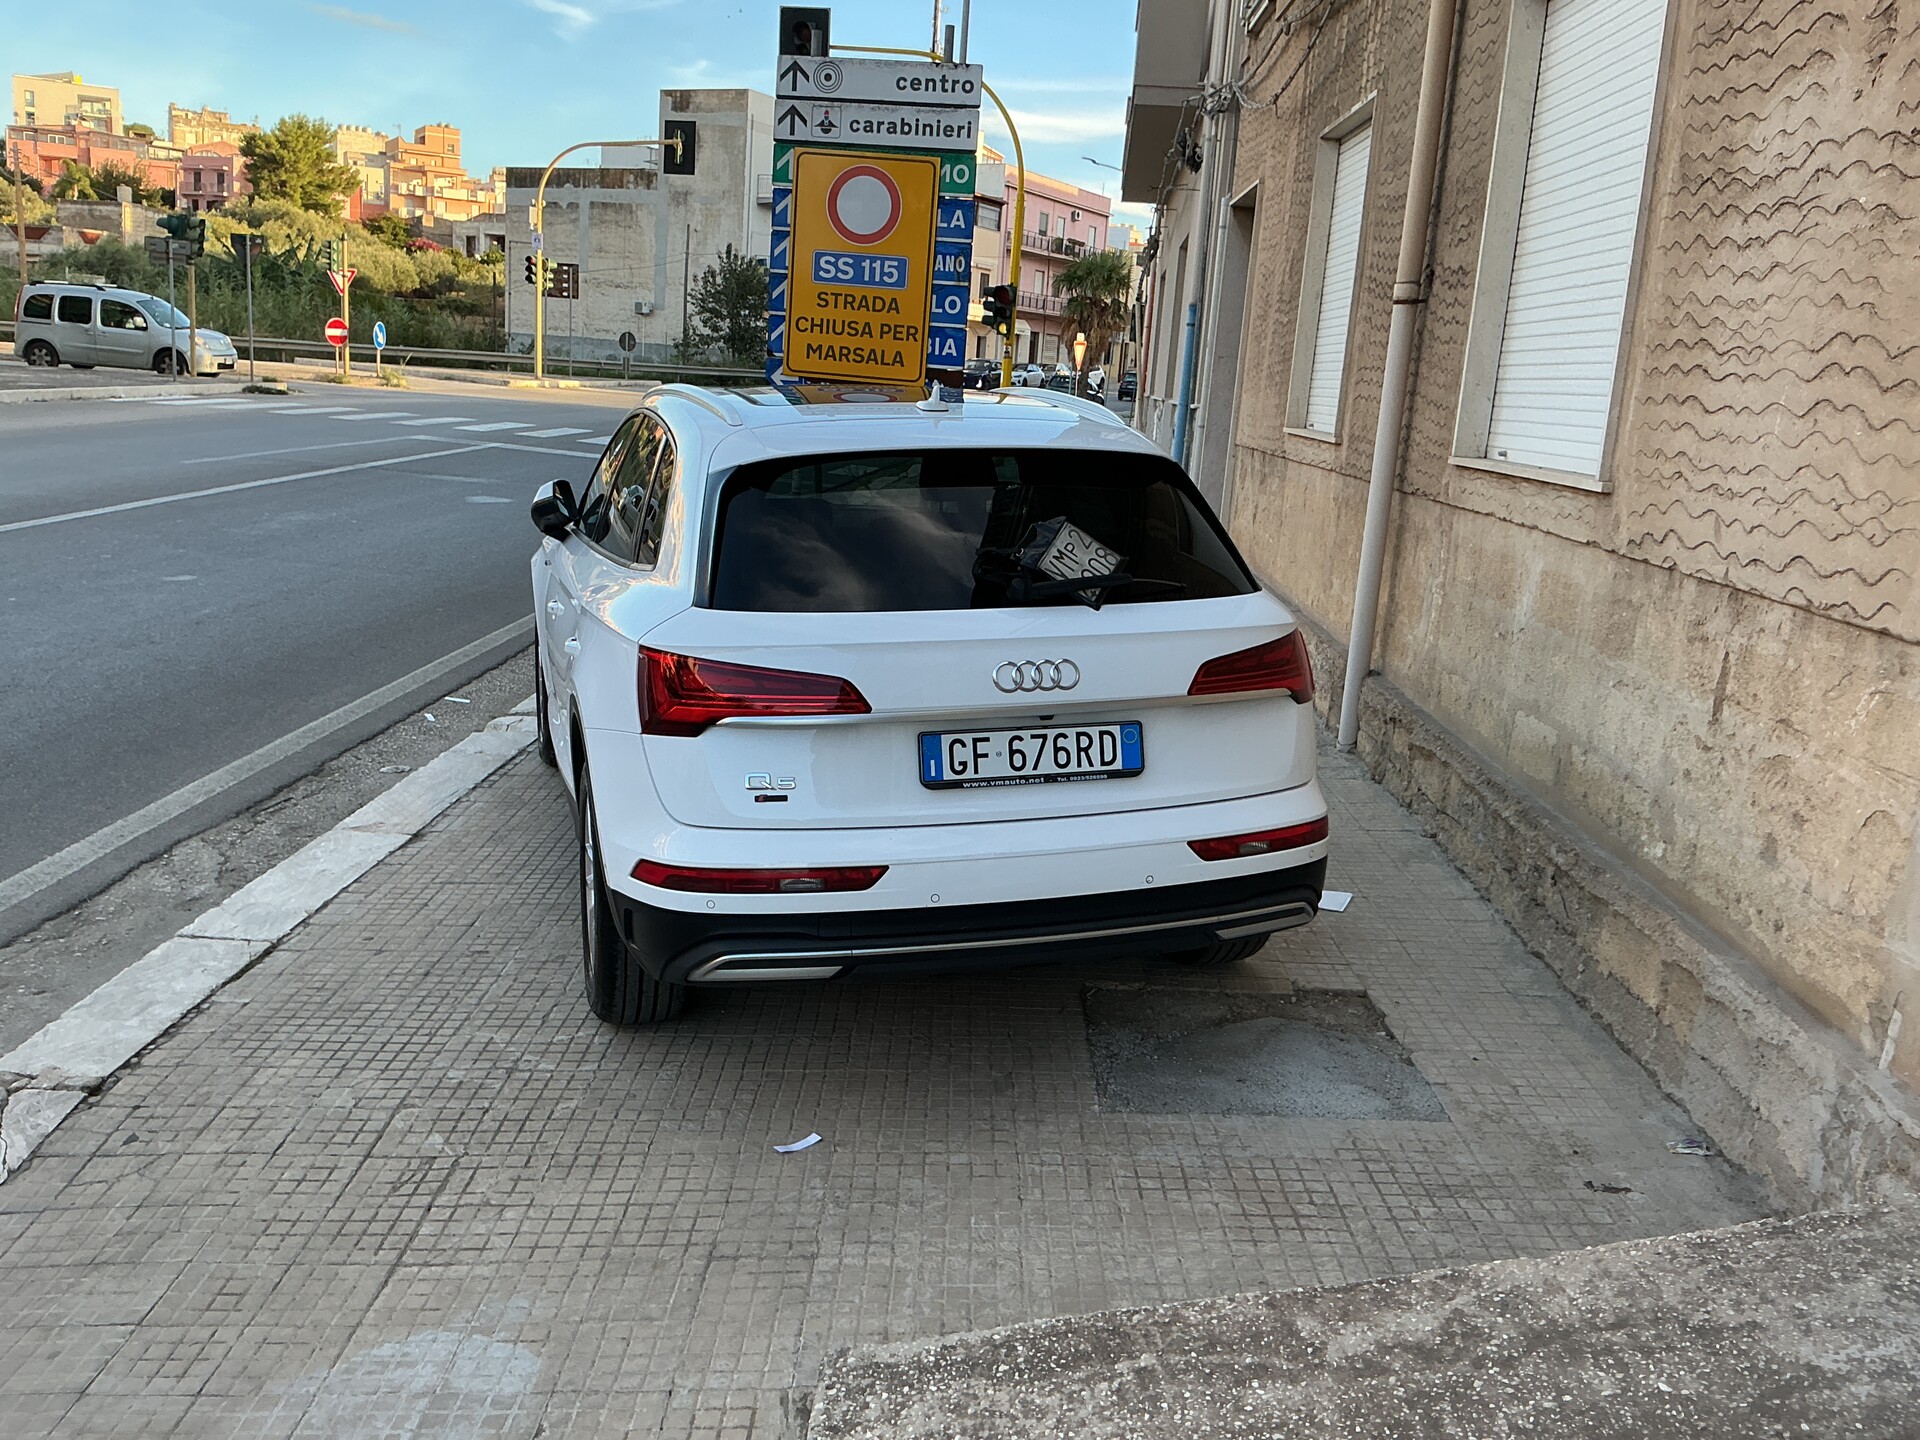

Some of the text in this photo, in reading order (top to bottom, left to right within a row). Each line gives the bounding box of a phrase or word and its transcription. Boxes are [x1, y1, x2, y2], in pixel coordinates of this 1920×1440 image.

[896, 74, 975, 94] centro
[849, 118, 972, 139] carabinieri
[818, 255, 899, 283] SS 115
[816, 291, 901, 315] STRADA
[794, 316, 919, 343] CHIUSA PER
[806, 343, 905, 368] MARSALA
[948, 729, 1118, 776] GF 676RD
[744, 771, 797, 791] Q5
[962, 776, 1045, 788] www.vmauto.net
